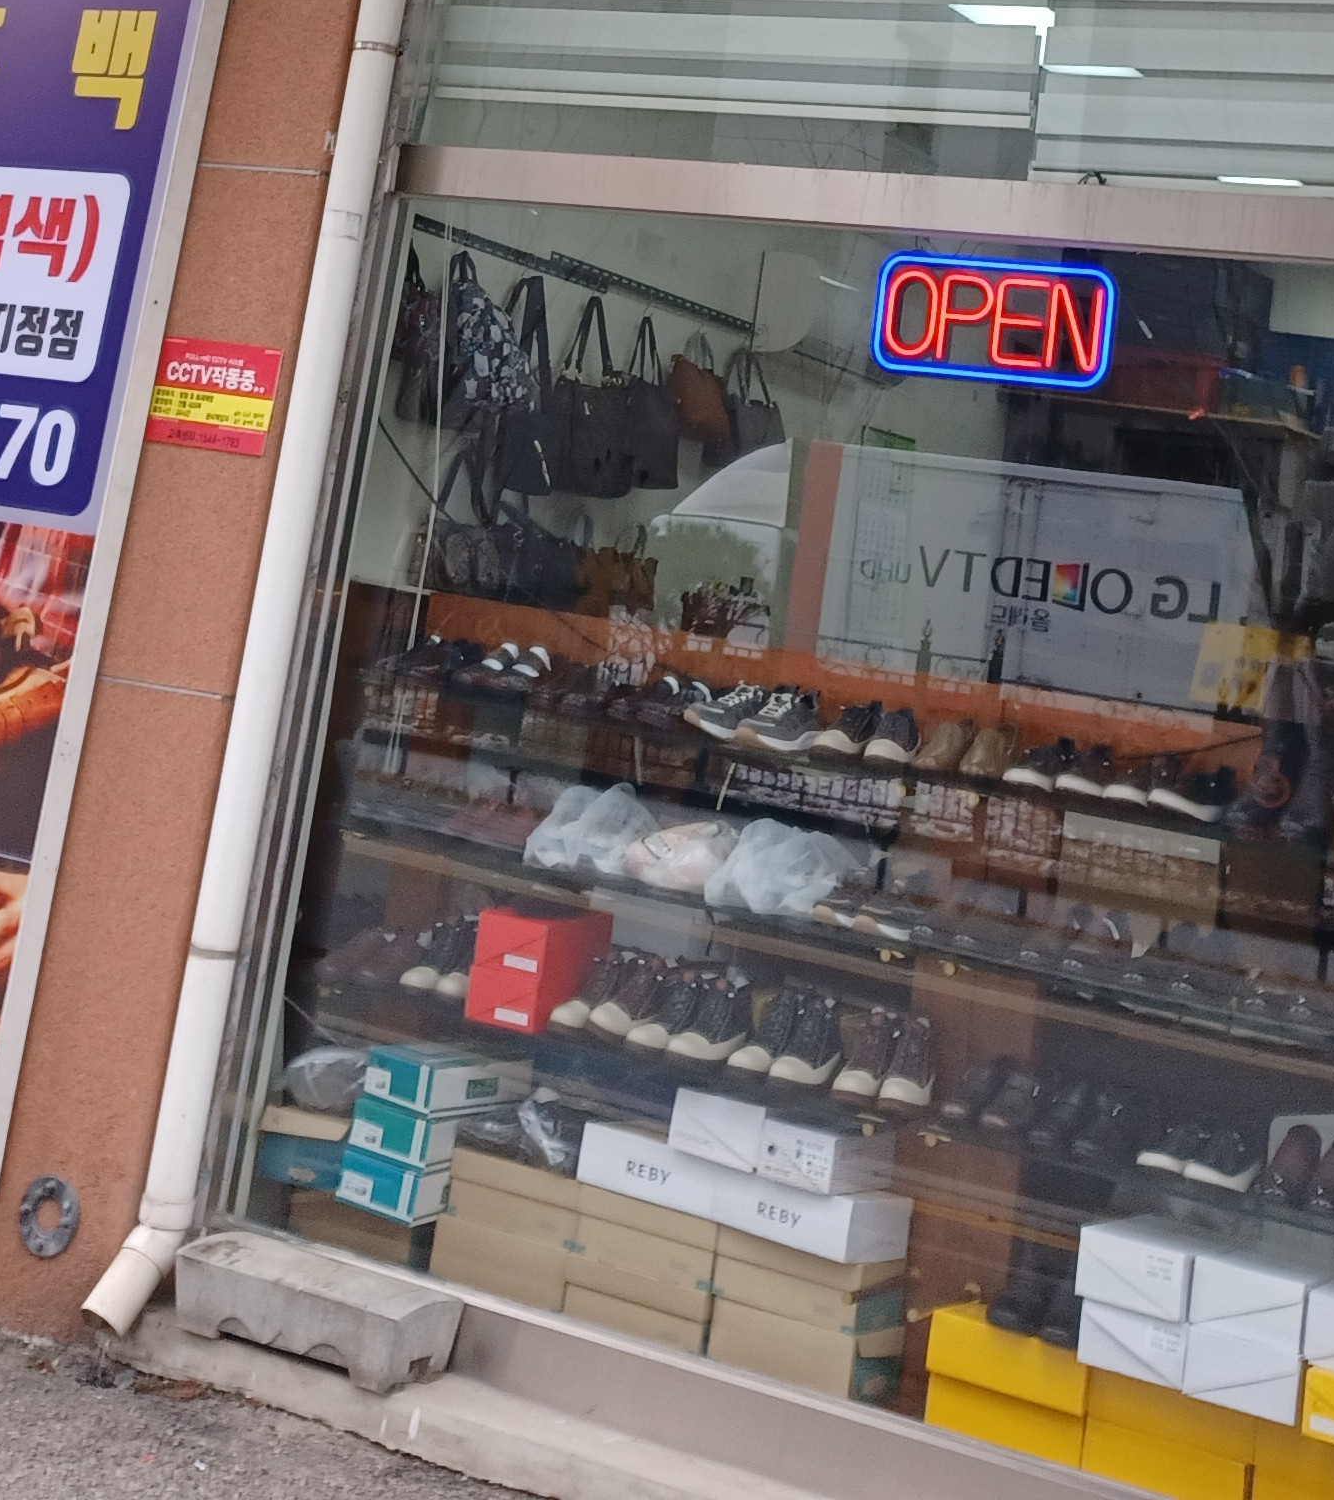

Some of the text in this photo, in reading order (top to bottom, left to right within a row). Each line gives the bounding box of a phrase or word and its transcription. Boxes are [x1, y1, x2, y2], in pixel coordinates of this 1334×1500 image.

[883, 264, 1107, 374] OPEN
[625, 1159, 672, 1186] REBY
[756, 1201, 803, 1229] REBY
